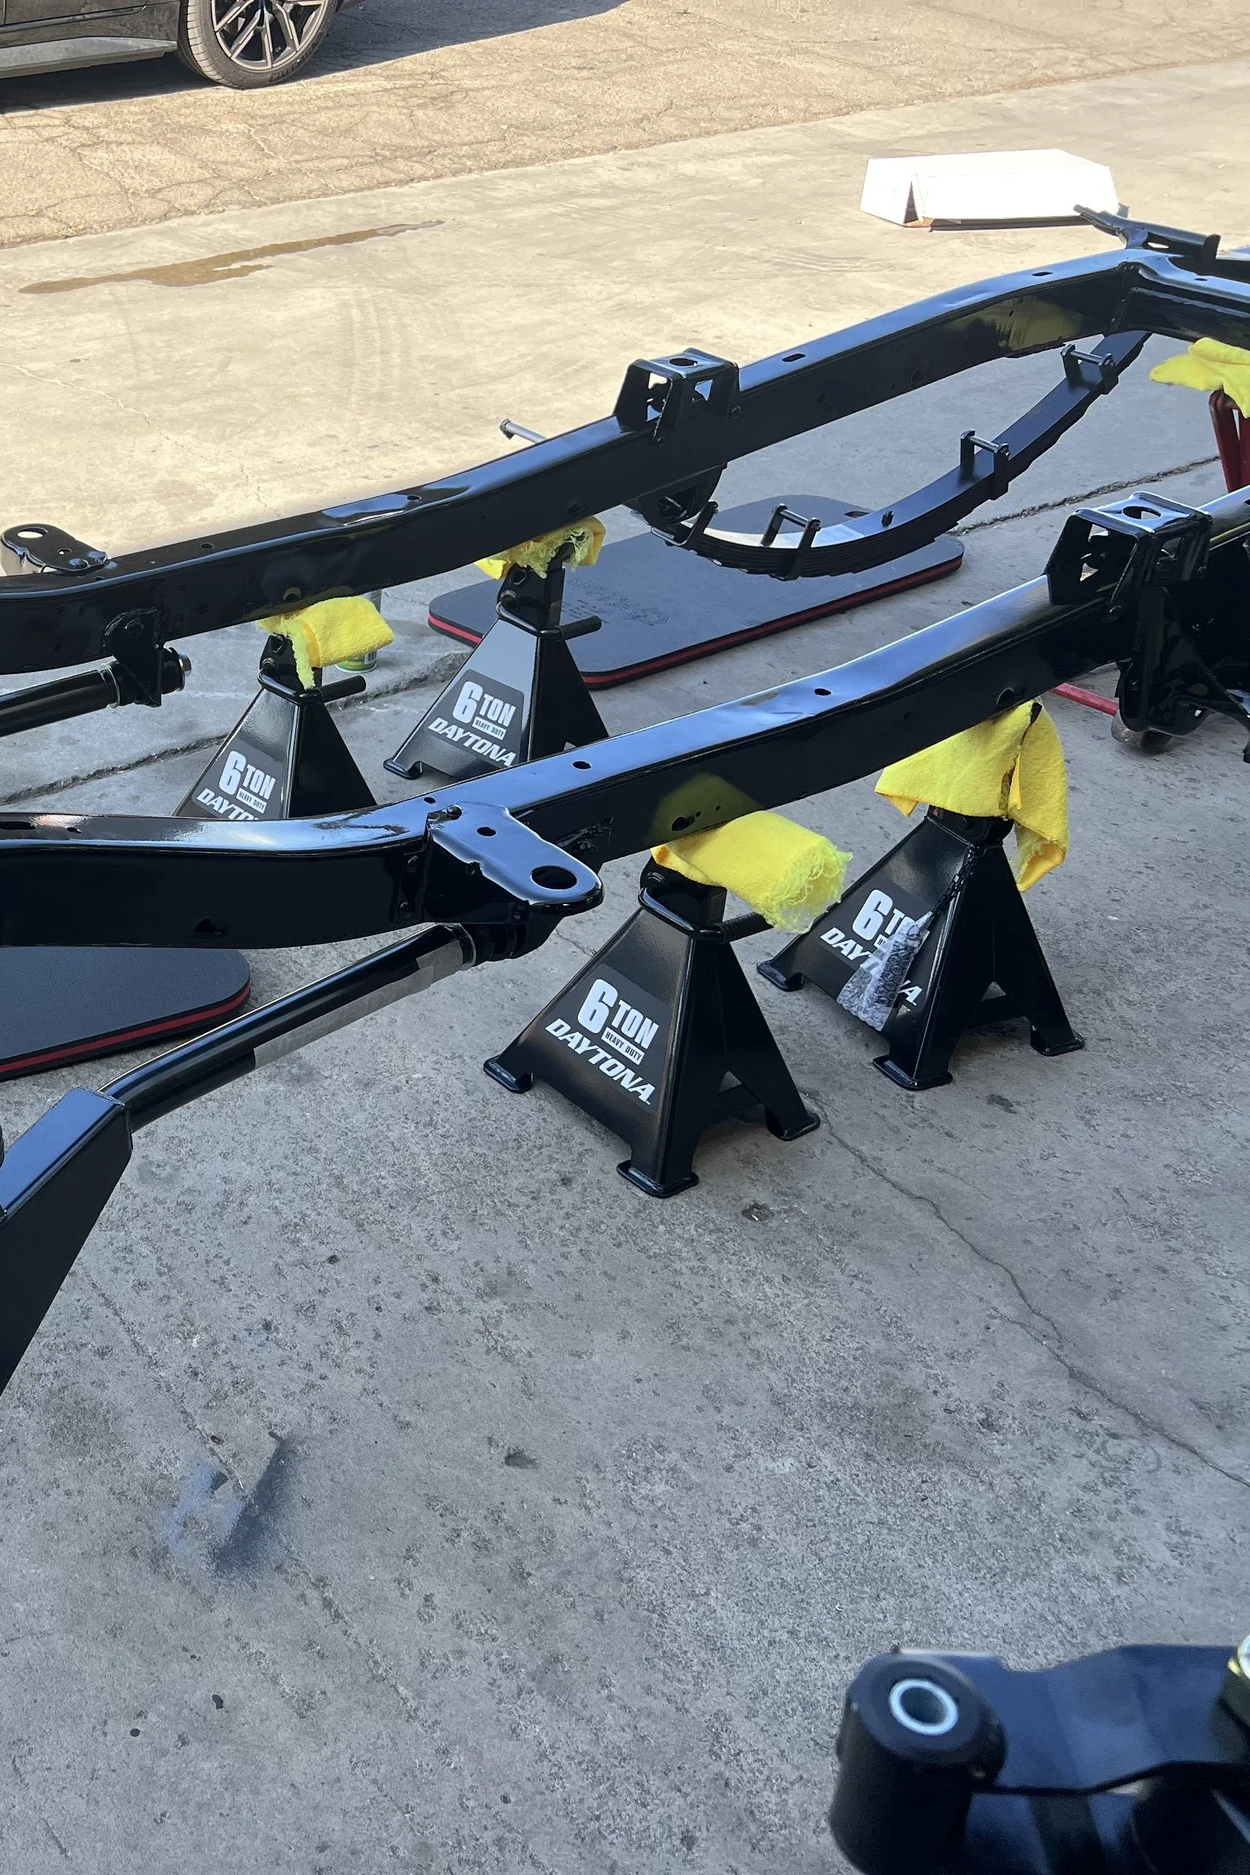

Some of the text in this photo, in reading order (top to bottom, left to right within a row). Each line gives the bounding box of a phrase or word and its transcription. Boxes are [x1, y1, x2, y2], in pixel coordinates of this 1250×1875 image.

[453, 681, 516, 727] 6 TON
[428, 717, 516, 767] DAYTONA
[491, 727, 505, 737] DUTY
[219, 751, 276, 800] 6 TON
[197, 788, 259, 820] DAYTO
[852, 889, 893, 940] 6
[577, 979, 659, 1050] 6 TON
[545, 1018, 655, 1104] DAYTONA
[605, 1031, 643, 1061] HEAVY DUTY
